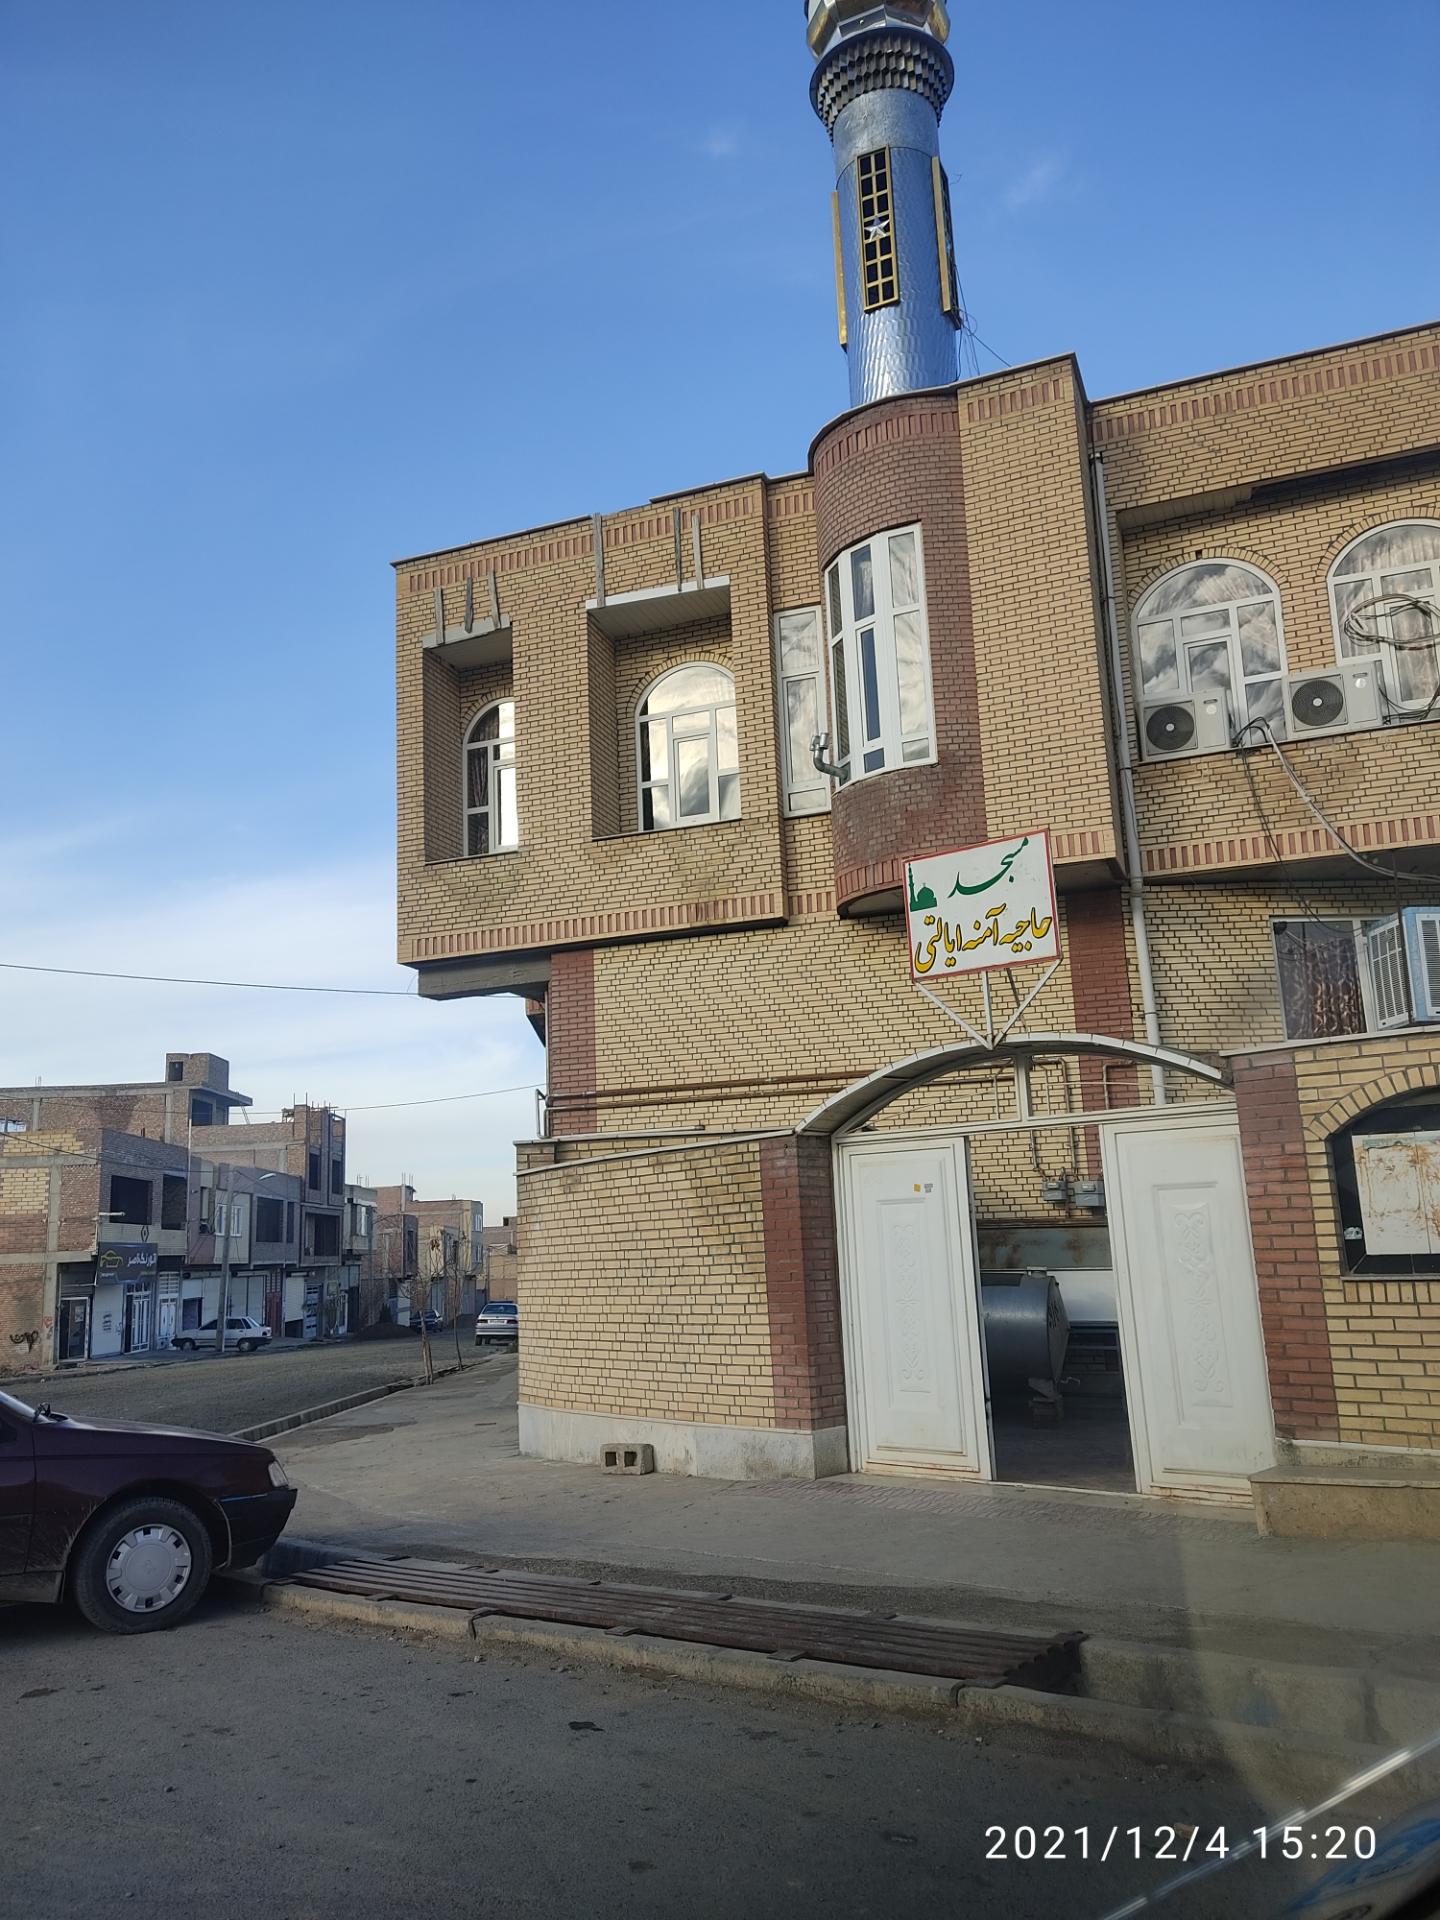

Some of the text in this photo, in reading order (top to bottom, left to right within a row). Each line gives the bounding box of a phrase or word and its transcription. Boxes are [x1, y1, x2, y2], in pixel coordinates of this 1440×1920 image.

[947, 836, 1029, 898] مسجد
[914, 903, 1053, 973] حاجیه آمنه ایالتی
